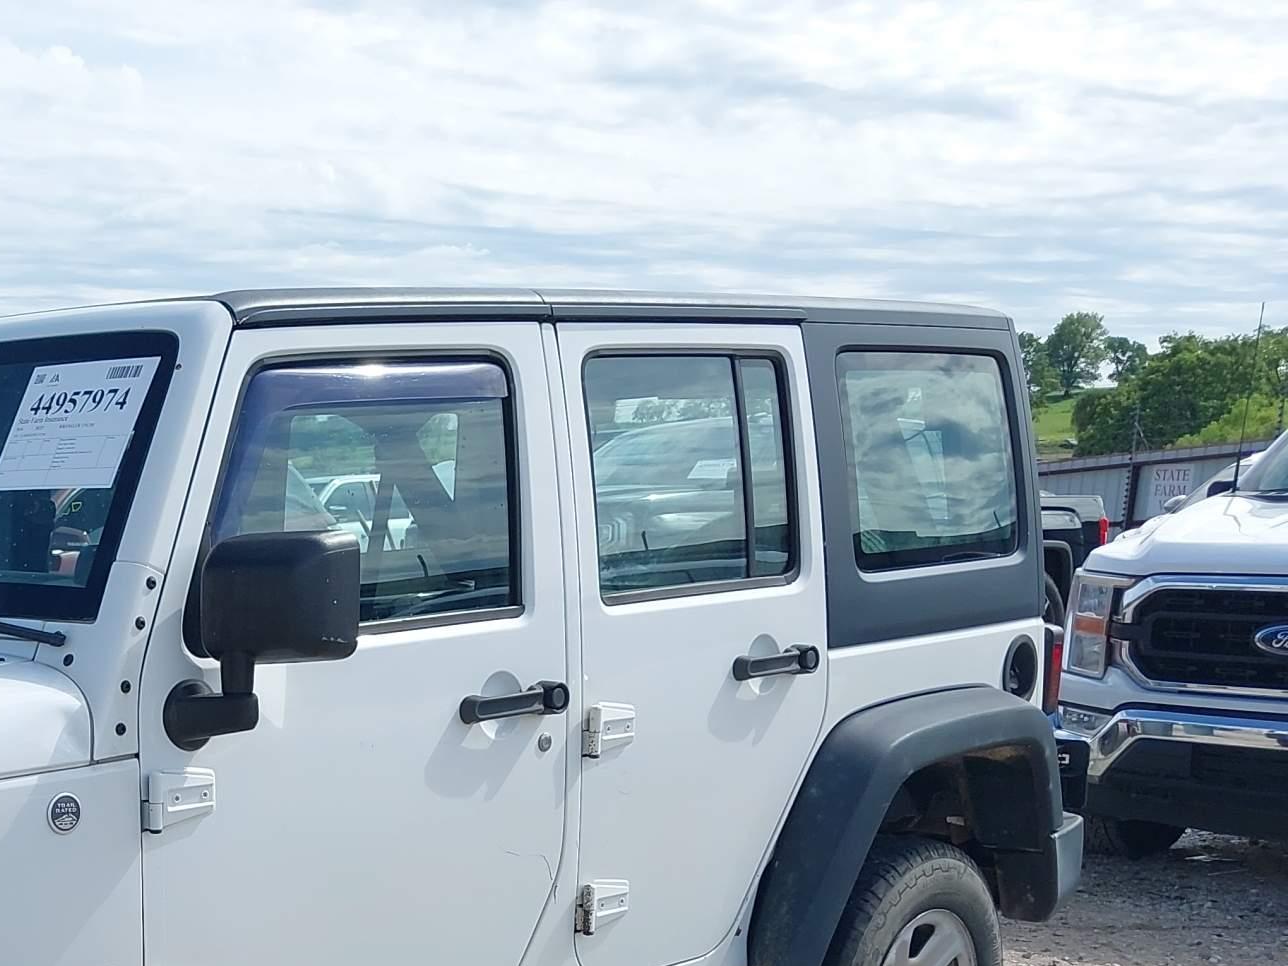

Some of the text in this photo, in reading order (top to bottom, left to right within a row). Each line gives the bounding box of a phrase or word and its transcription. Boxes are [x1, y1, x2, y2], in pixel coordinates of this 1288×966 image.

[30, 387, 131, 416] 44957974
[1153, 469, 1191, 481] STATE
[1154, 484, 1187, 497] FARM
